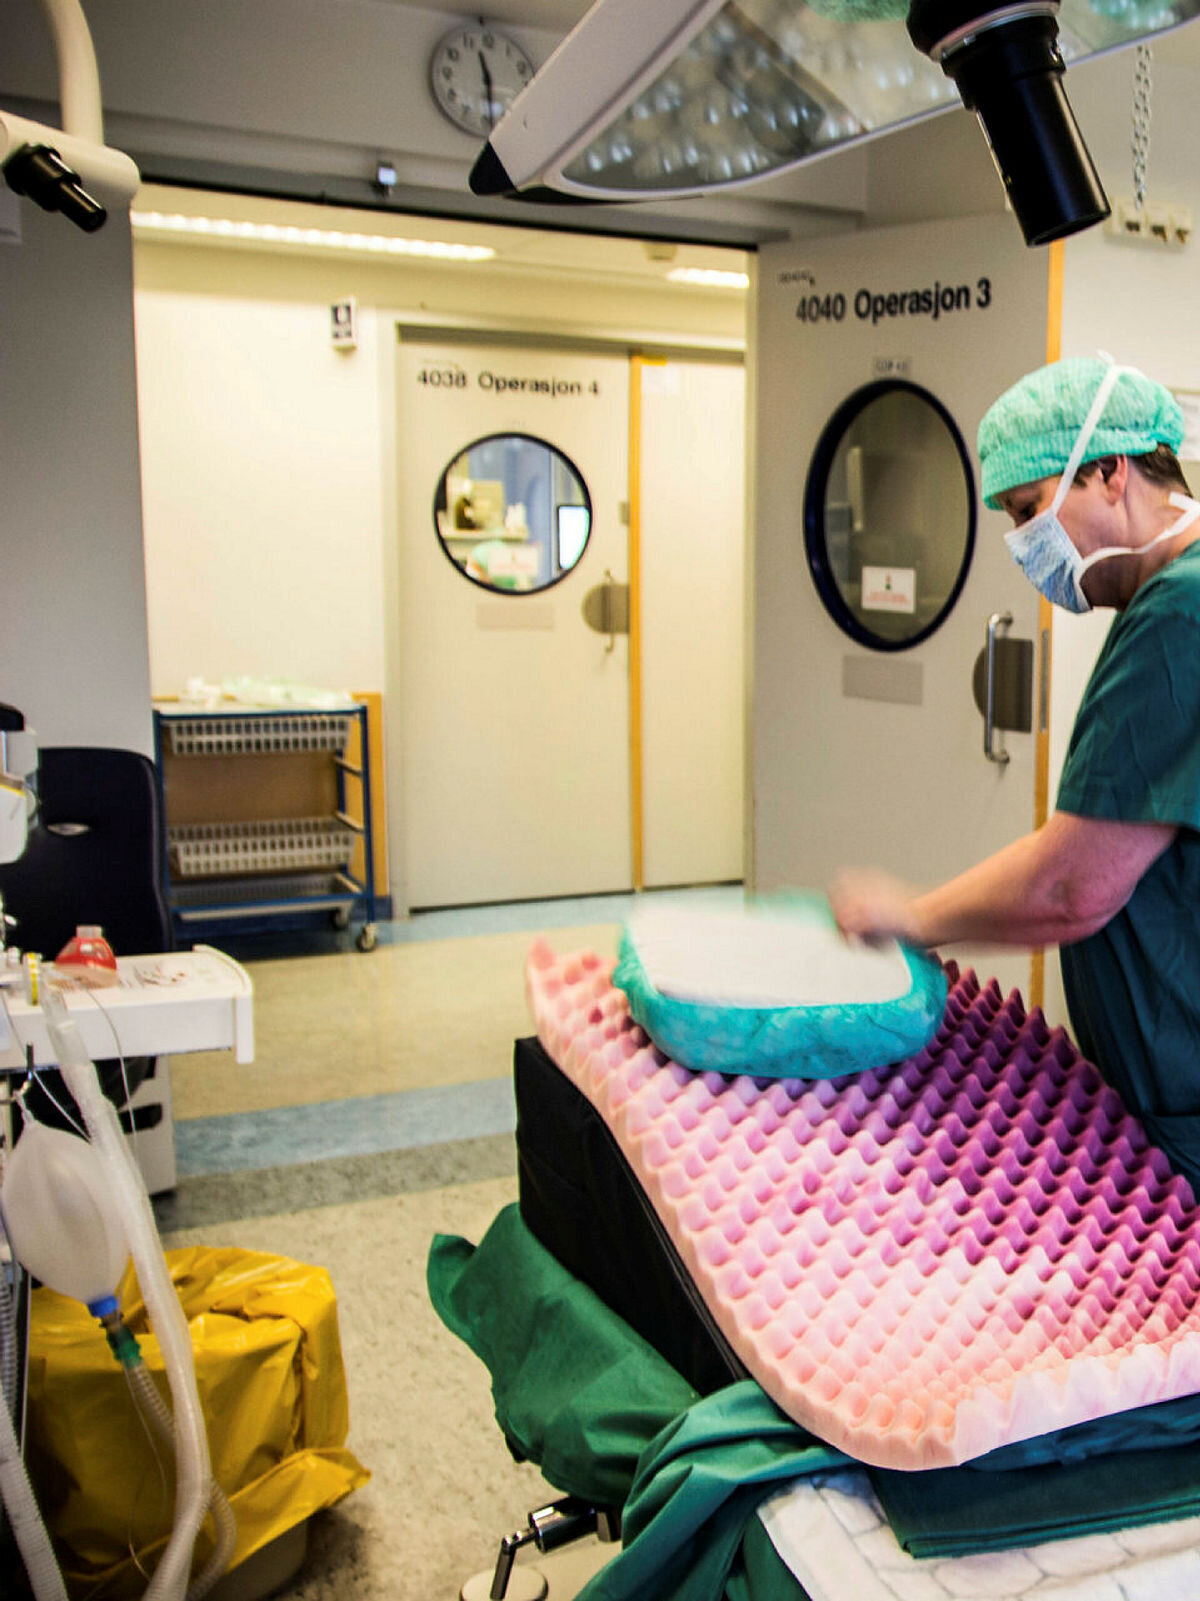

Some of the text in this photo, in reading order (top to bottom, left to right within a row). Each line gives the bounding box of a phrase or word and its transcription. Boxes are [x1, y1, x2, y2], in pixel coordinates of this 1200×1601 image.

[796, 277, 992, 325] 4040 Operasjon 3
[417, 369, 600, 397] 4038 Operasjon 4
